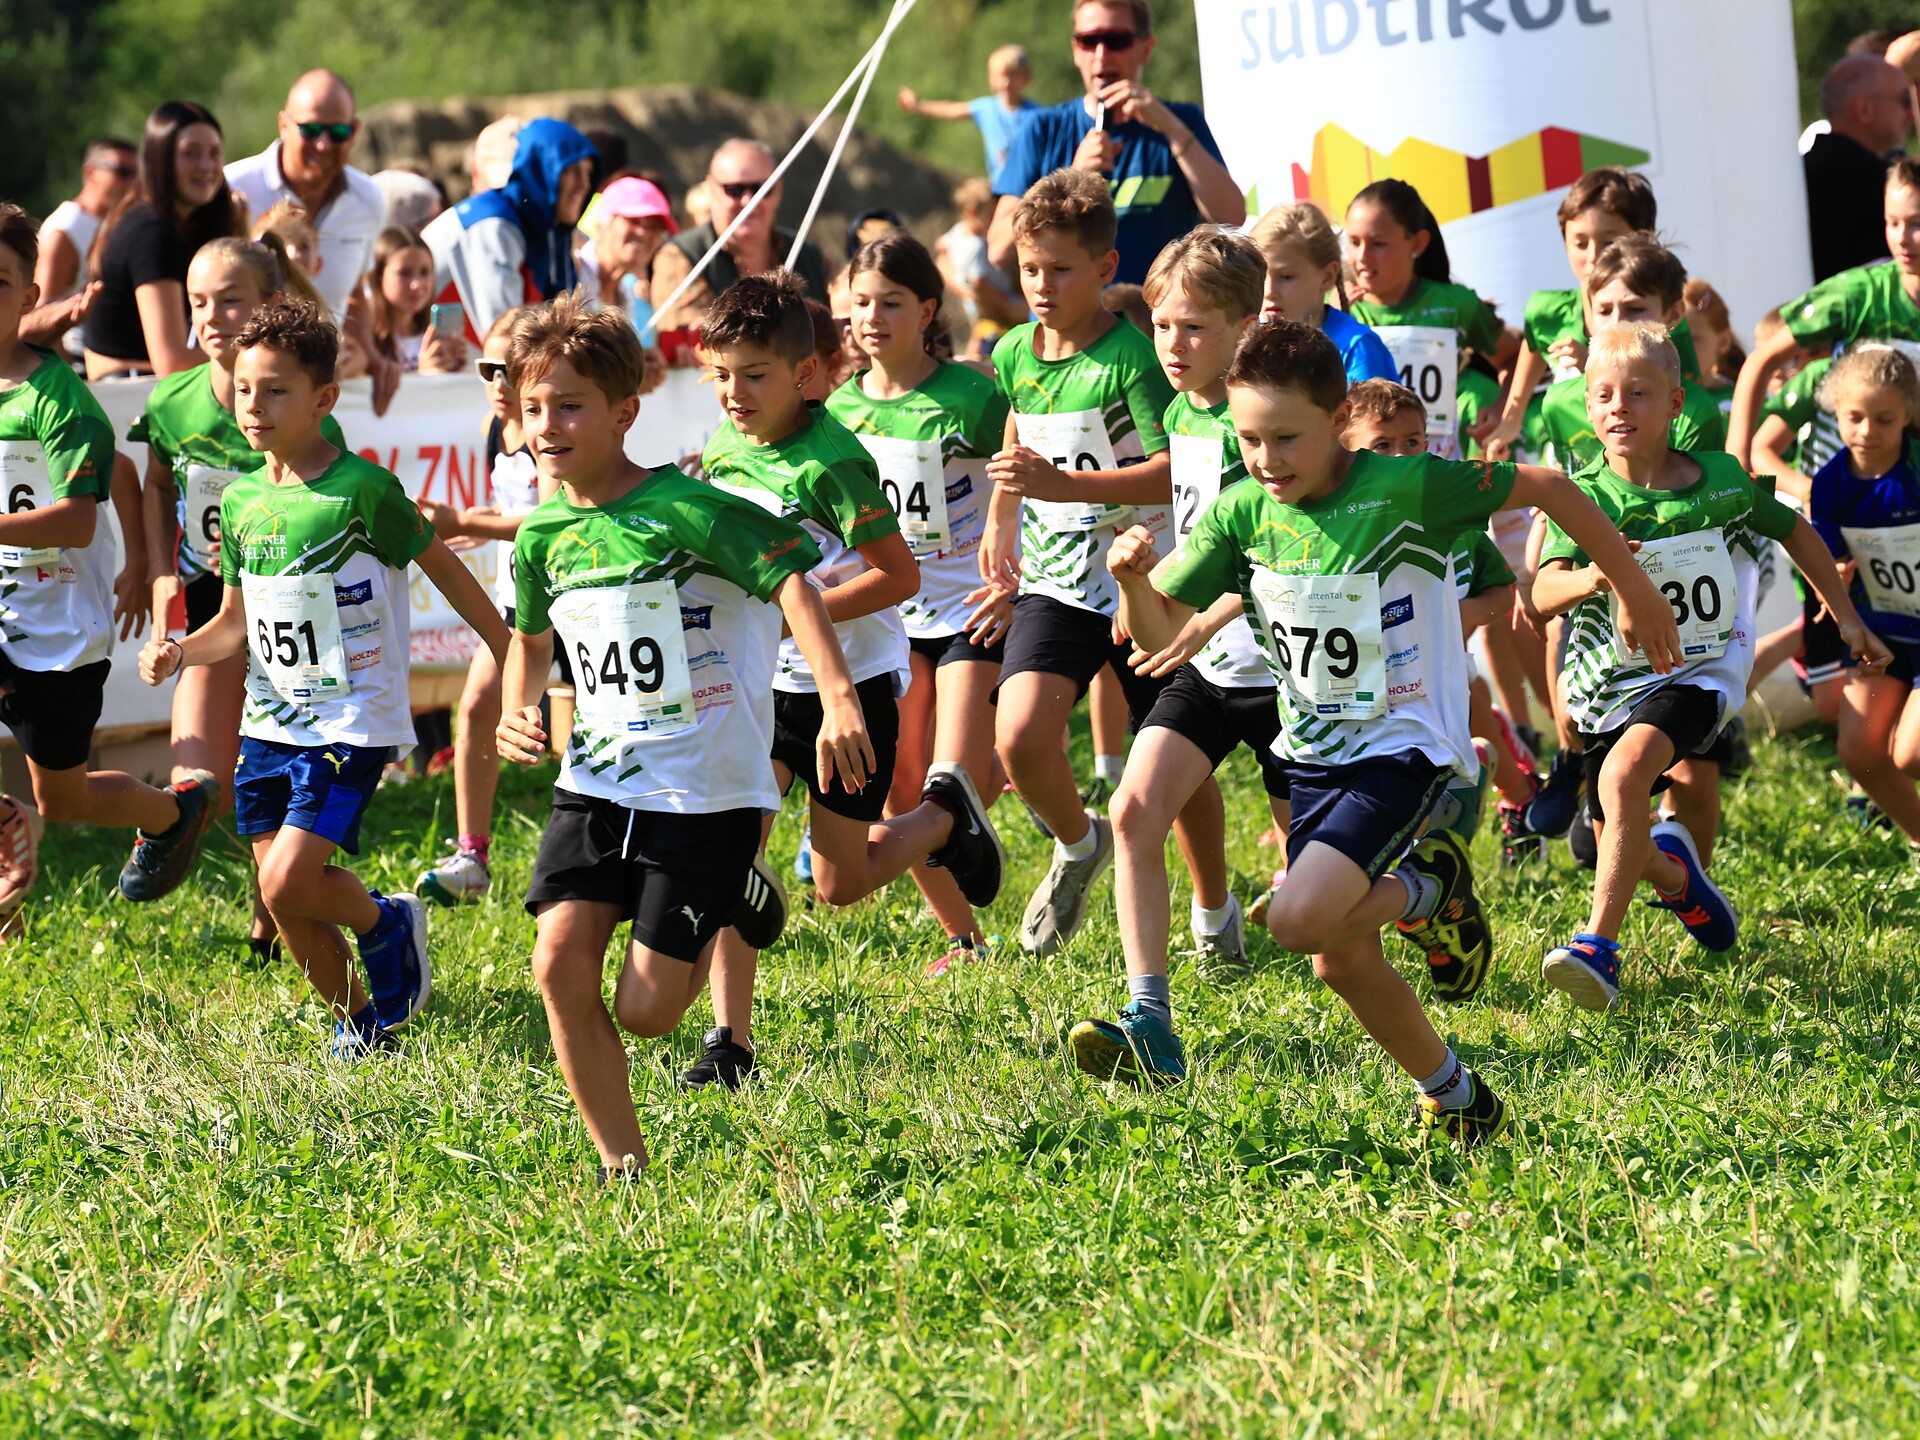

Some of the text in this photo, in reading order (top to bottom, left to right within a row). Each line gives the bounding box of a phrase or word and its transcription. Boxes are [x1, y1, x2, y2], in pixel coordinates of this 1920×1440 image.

[0, 484, 36, 515] 6
[1660, 575, 1721, 626] 30
[1870, 558, 1920, 594] 60
[257, 618, 319, 667] 651
[577, 637, 664, 695] 649
[1272, 620, 1359, 679] 679
